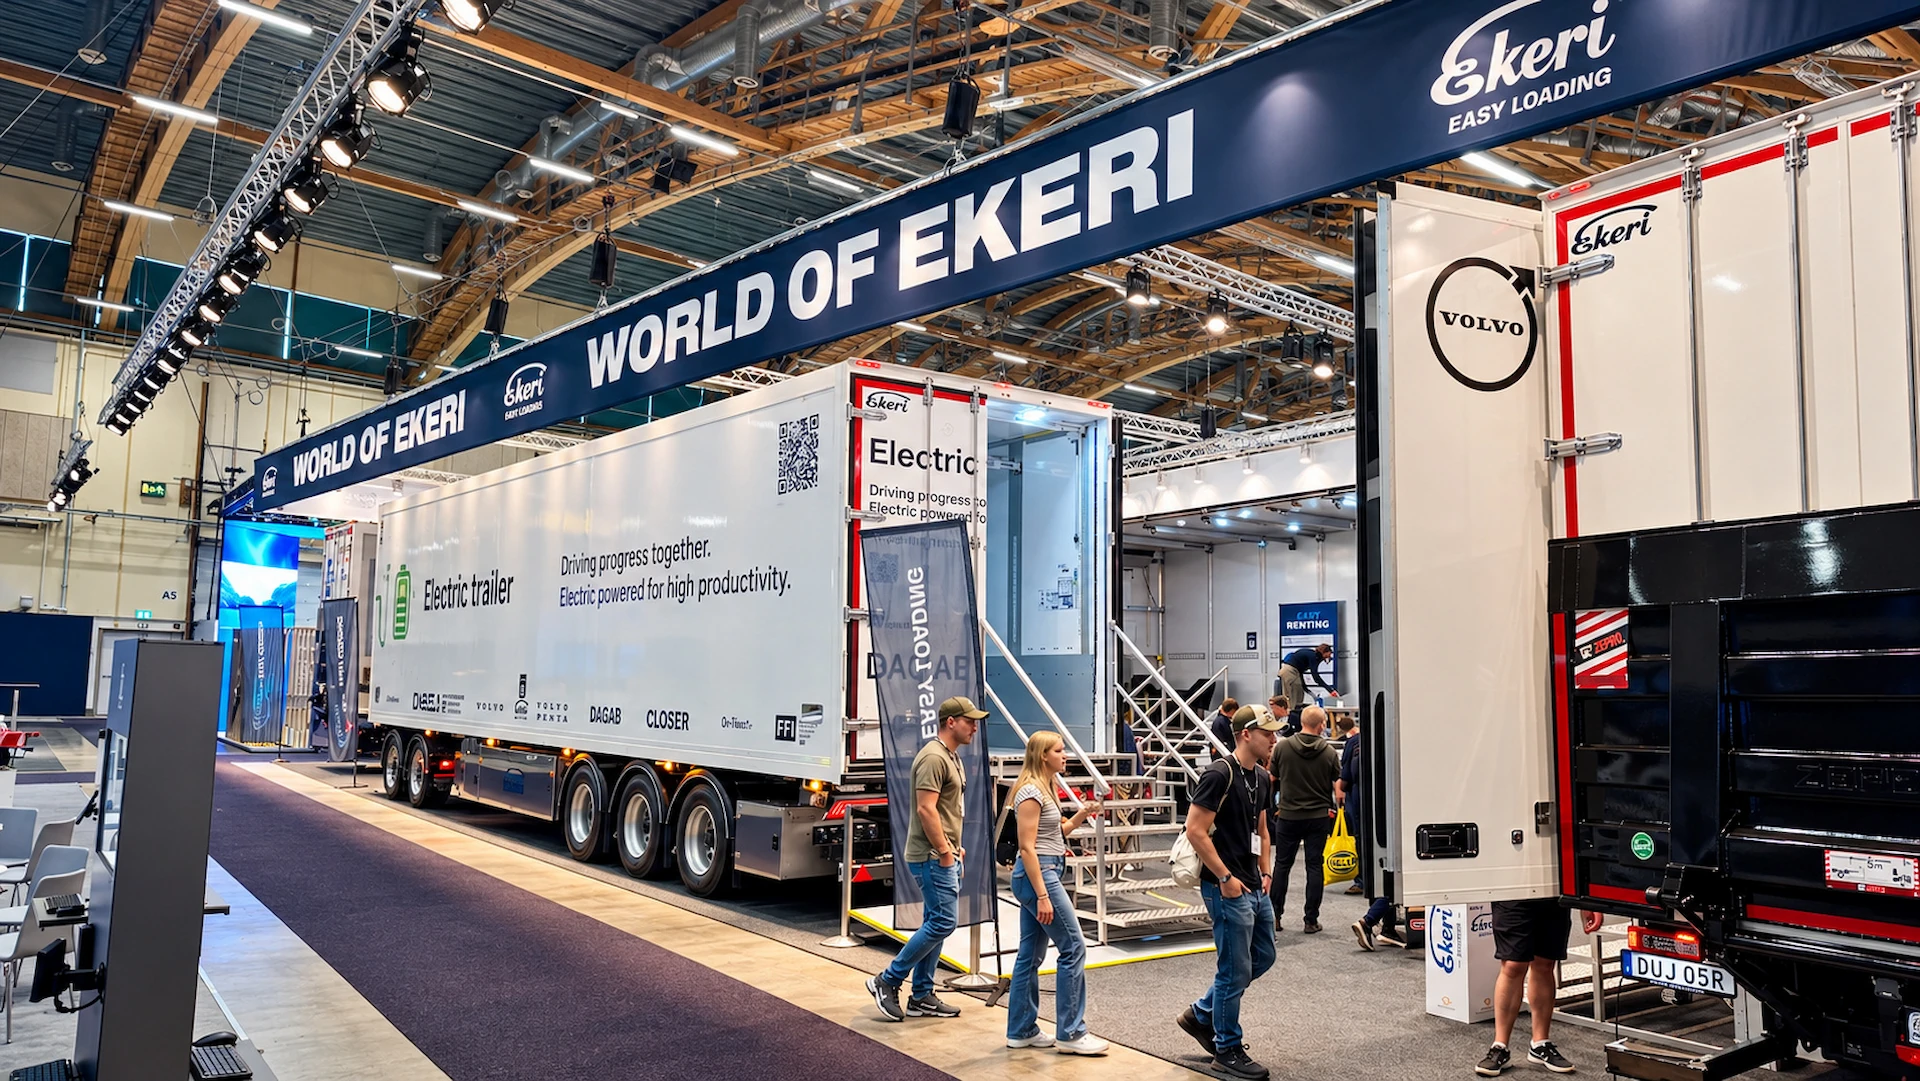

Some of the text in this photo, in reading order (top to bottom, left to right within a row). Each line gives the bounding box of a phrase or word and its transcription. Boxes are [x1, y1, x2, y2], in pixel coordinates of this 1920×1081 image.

[1430, 0, 1616, 106] Ekeri
[1448, 66, 1612, 134] EASY LOADING
[1571, 204, 1658, 255] Ekeri
[587, 109, 1196, 390] WORLD OF EKERI
[1439, 310, 1524, 336] VOLVO
[504, 362, 547, 407] Ekeri
[866, 391, 911, 413] Ekeri
[293, 433, 356, 487] WORLD
[359, 419, 390, 464] OF
[394, 389, 466, 454] EKERI
[870, 437, 979, 476] Electric
[869, 484, 915, 503] Driving
[918, 492, 971, 507] progress
[869, 502, 917, 518] Electric
[561, 536, 712, 578] Driving progress together.
[424, 568, 514, 612] Electric trailer
[559, 566, 792, 609] Electric powered for high productivity.
[1286, 620, 1330, 630] RENTING
[476, 702, 504, 712] VOLVO
[589, 705, 622, 725] DAGAB
[646, 709, 690, 731] CLOSER
[776, 719, 795, 738] FFI
[1430, 905, 1455, 974] Ekeri
[1637, 956, 1676, 981] DUJ
[1683, 965, 1725, 991] 05R
